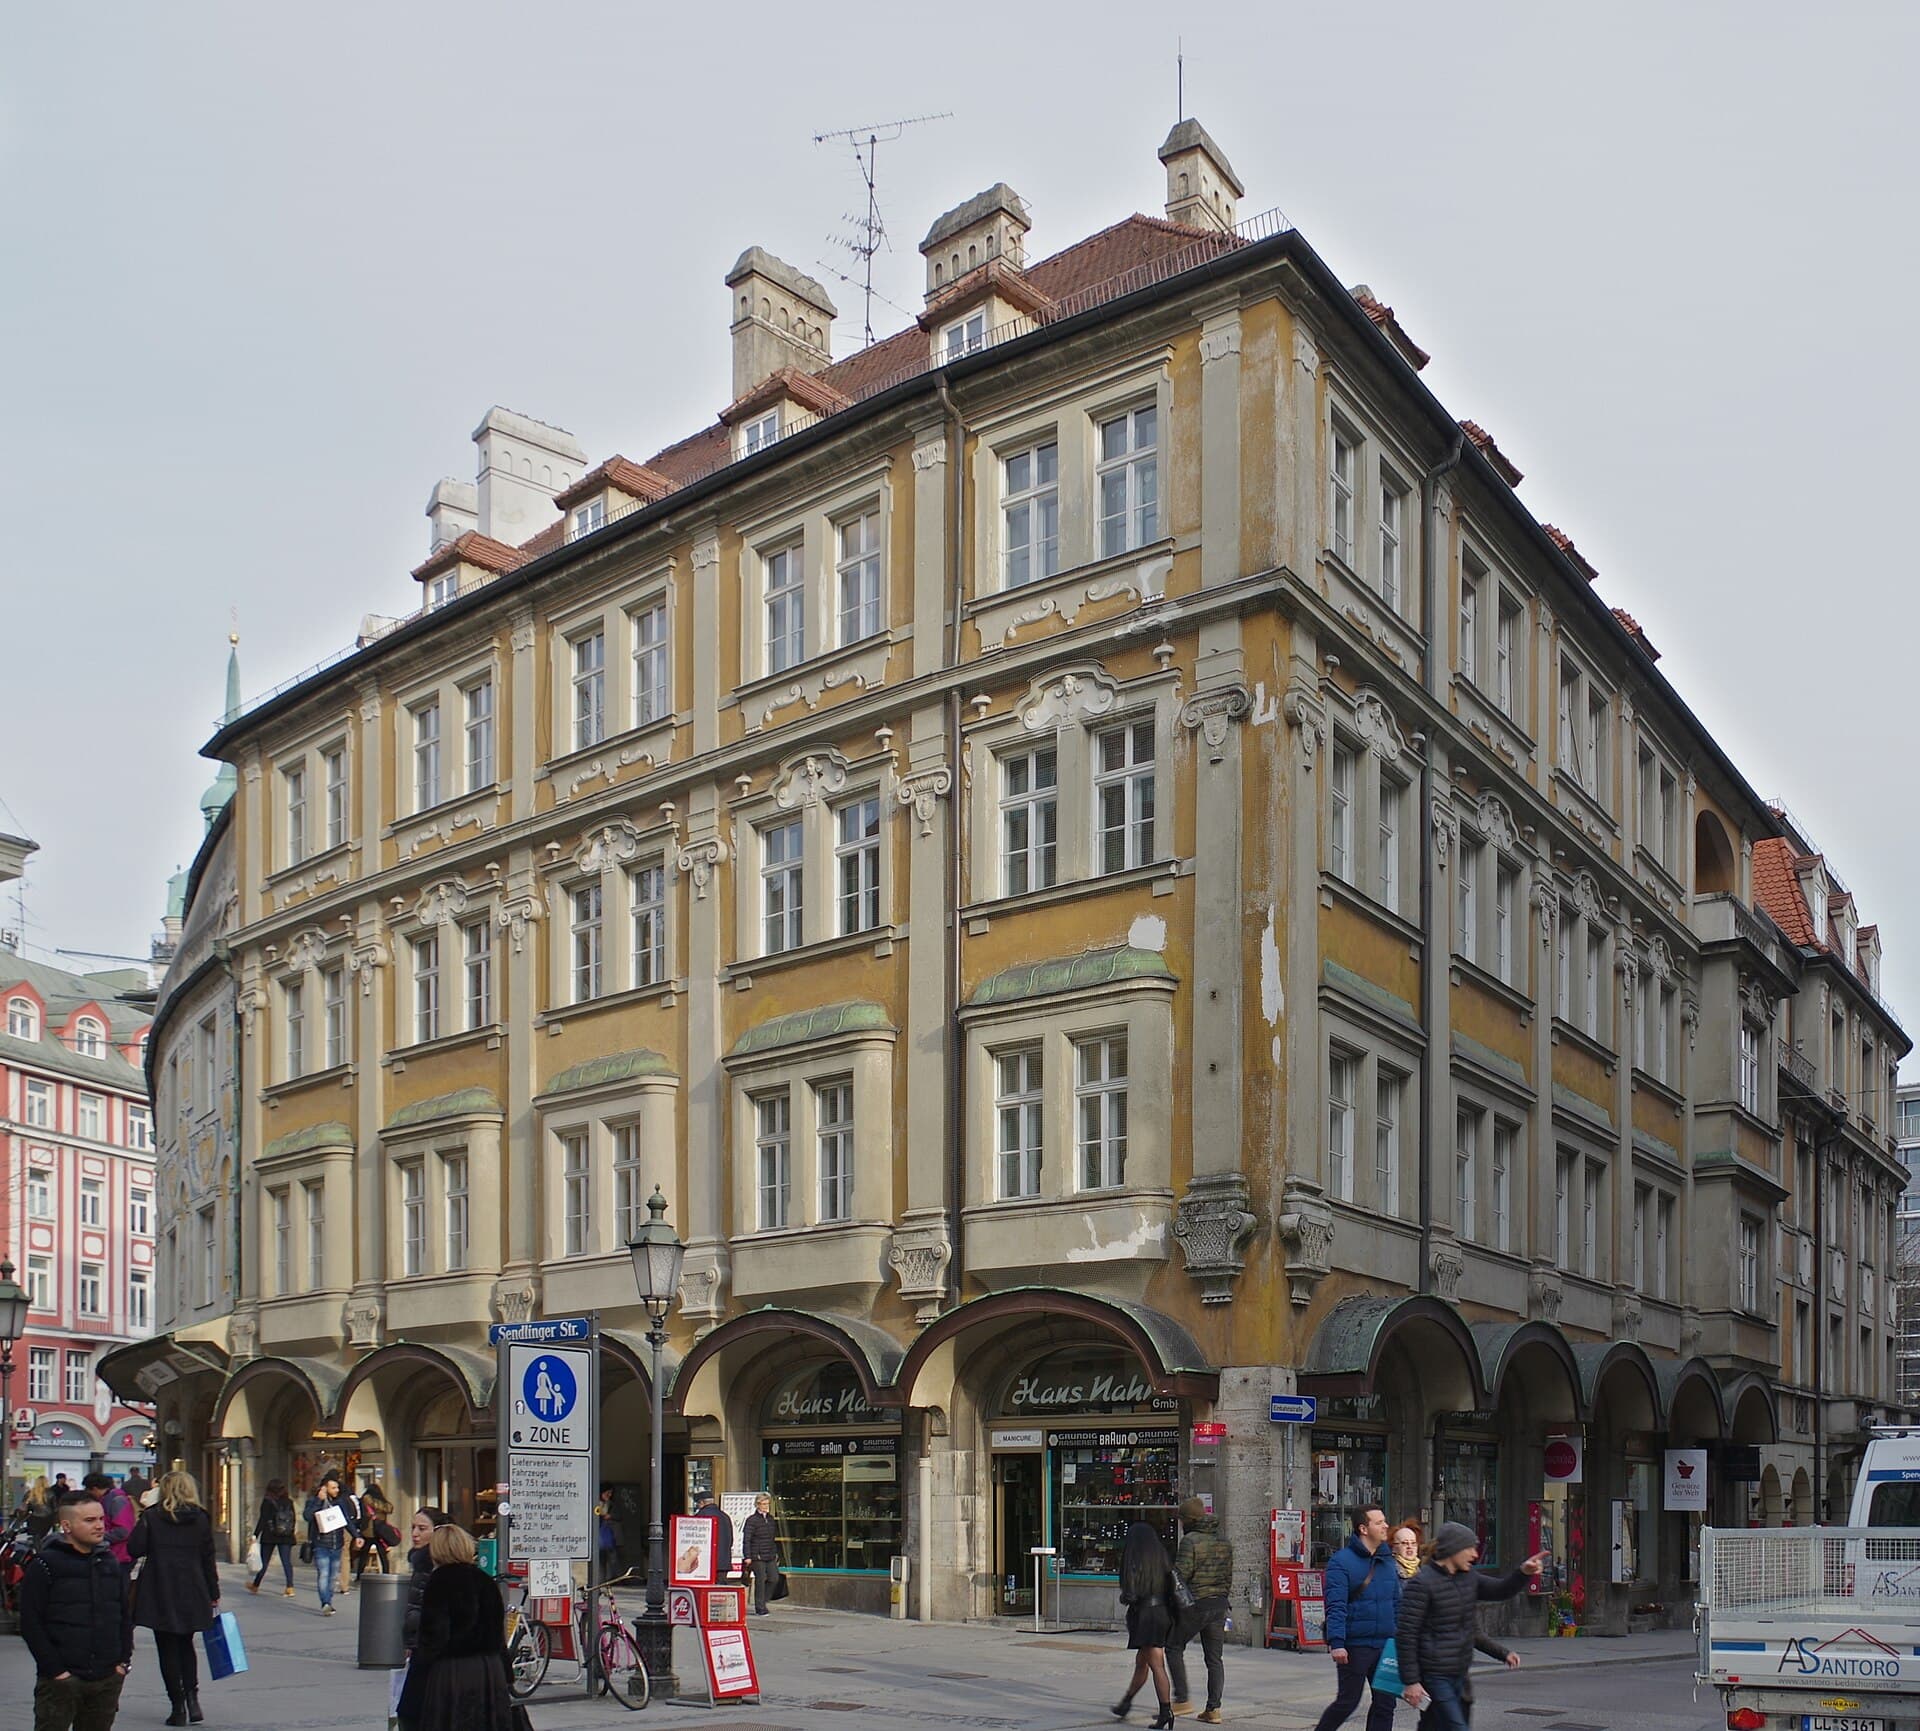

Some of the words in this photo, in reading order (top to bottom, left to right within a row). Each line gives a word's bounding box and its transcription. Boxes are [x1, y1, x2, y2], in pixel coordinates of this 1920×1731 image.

[498, 1324, 557, 1341] Sendlinger
[560, 1321, 580, 1337] Str.
[1011, 1377, 1084, 1405] Hans
[777, 1391, 832, 1415] Hans
[529, 1427, 571, 1444] ZONE
[1099, 1431, 1127, 1446] BRAUN
[1138, 1430, 1179, 1438] GRUNDIG
[820, 1441, 843, 1455] BRAUN
[511, 1458, 560, 1467] Lieferverkehr
[562, 1459, 573, 1468] für
[511, 1468, 548, 1478] Fahrzeuge
[511, 1479, 522, 1487] bis
[511, 1488, 565, 1499] Gesamtgewicht
[523, 1501, 561, 1512] Werktagen
[540, 1512, 553, 1520] Uhr
[555, 1512, 569, 1520] und
[540, 1522, 553, 1530] Uhr
[551, 1534, 587, 1545] Feiertagen
[565, 1545, 578, 1553] Uhr
[1277, 1574, 1290, 1594] tz
[544, 1586, 558, 1594] frei
[1814, 1718, 1831, 1731] LL
[1840, 1718, 1849, 1731] S
[1851, 1720, 1875, 1731] 161
